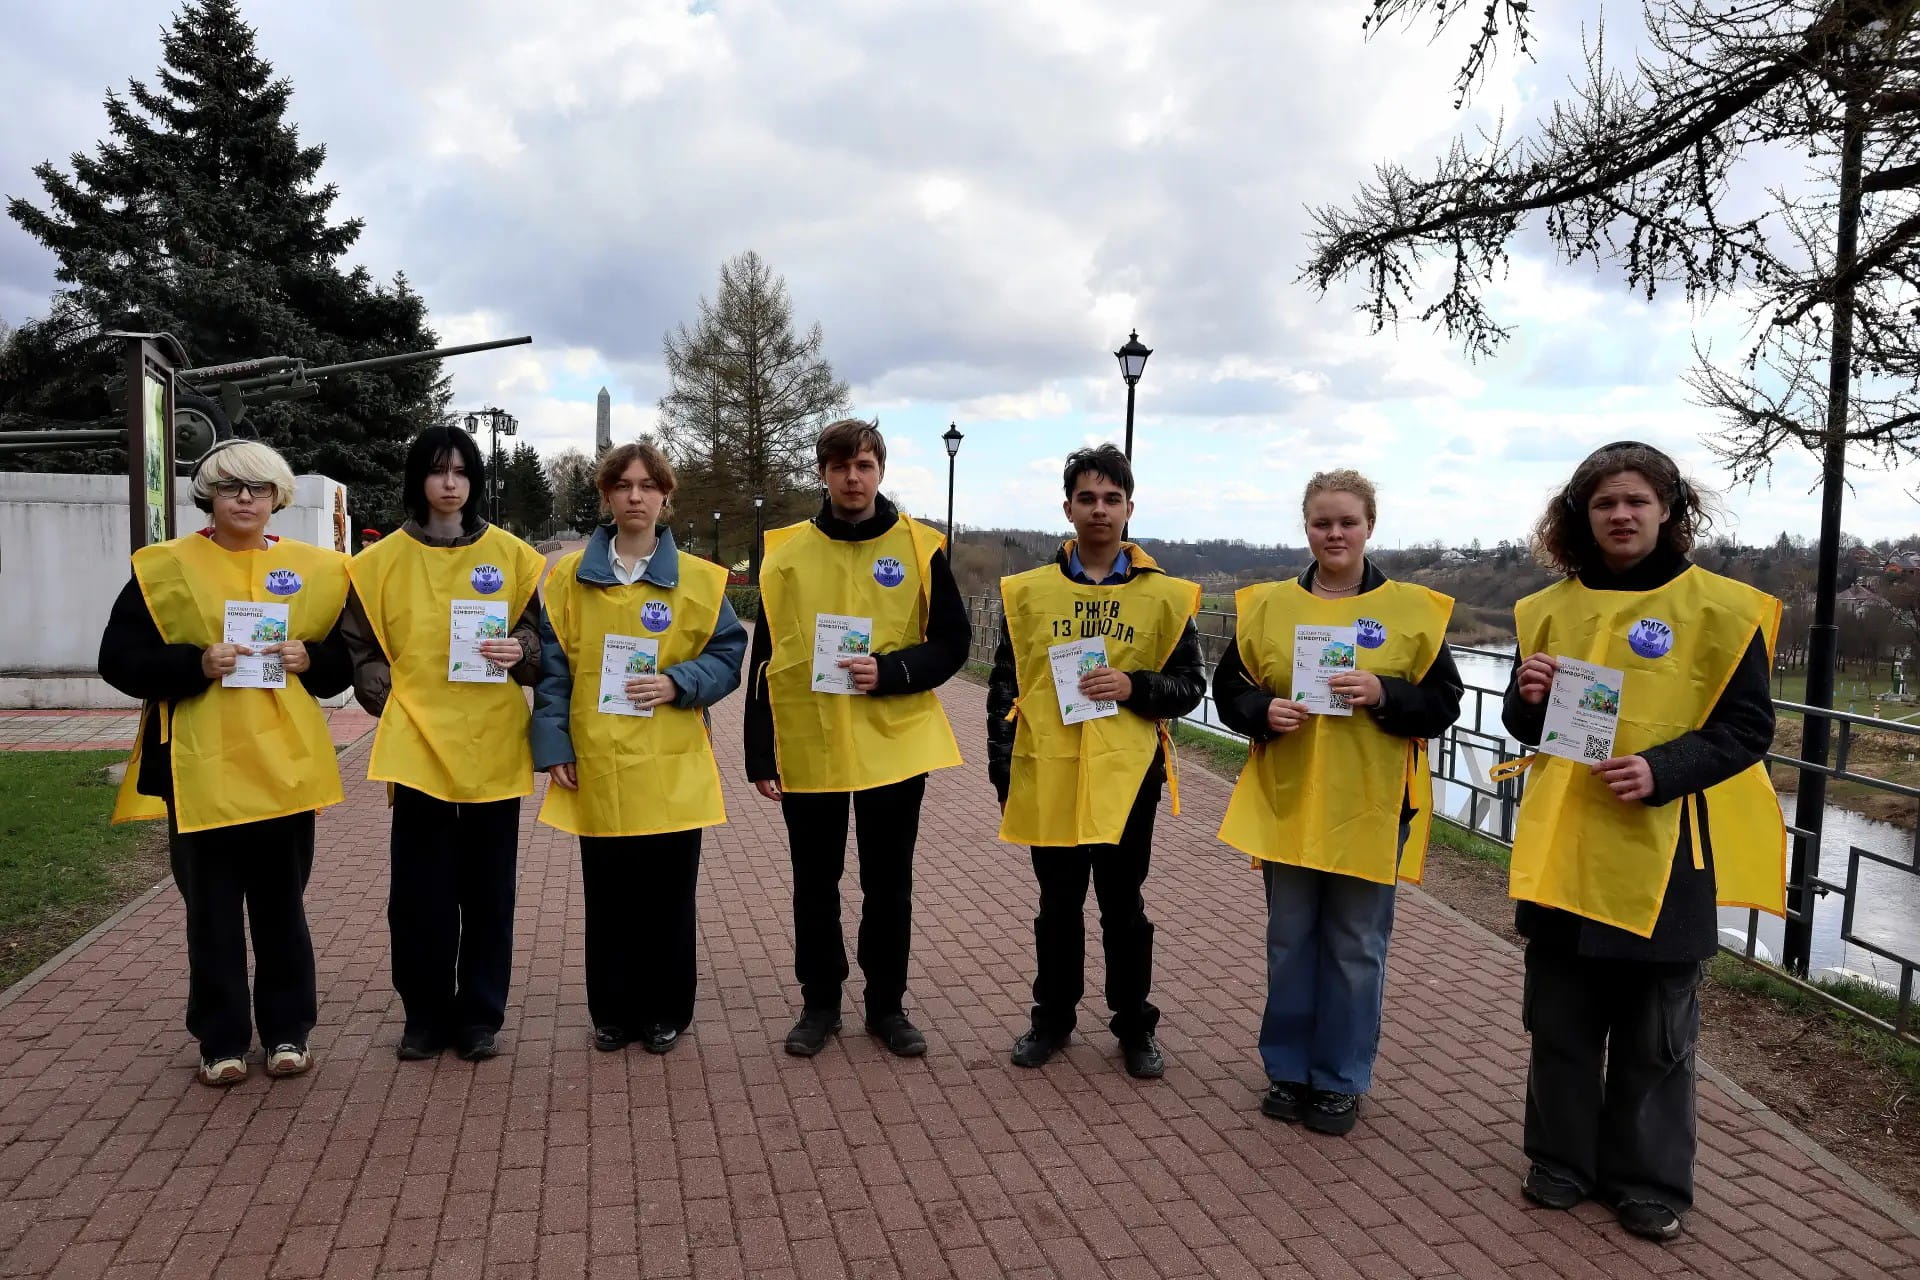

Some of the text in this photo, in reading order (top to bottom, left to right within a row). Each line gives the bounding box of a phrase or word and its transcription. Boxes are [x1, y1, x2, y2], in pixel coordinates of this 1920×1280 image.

[1074, 600, 1120, 619] РЖЕВ
[1052, 619, 1071, 638] 13
[1641, 620, 1670, 636] РИТМ
